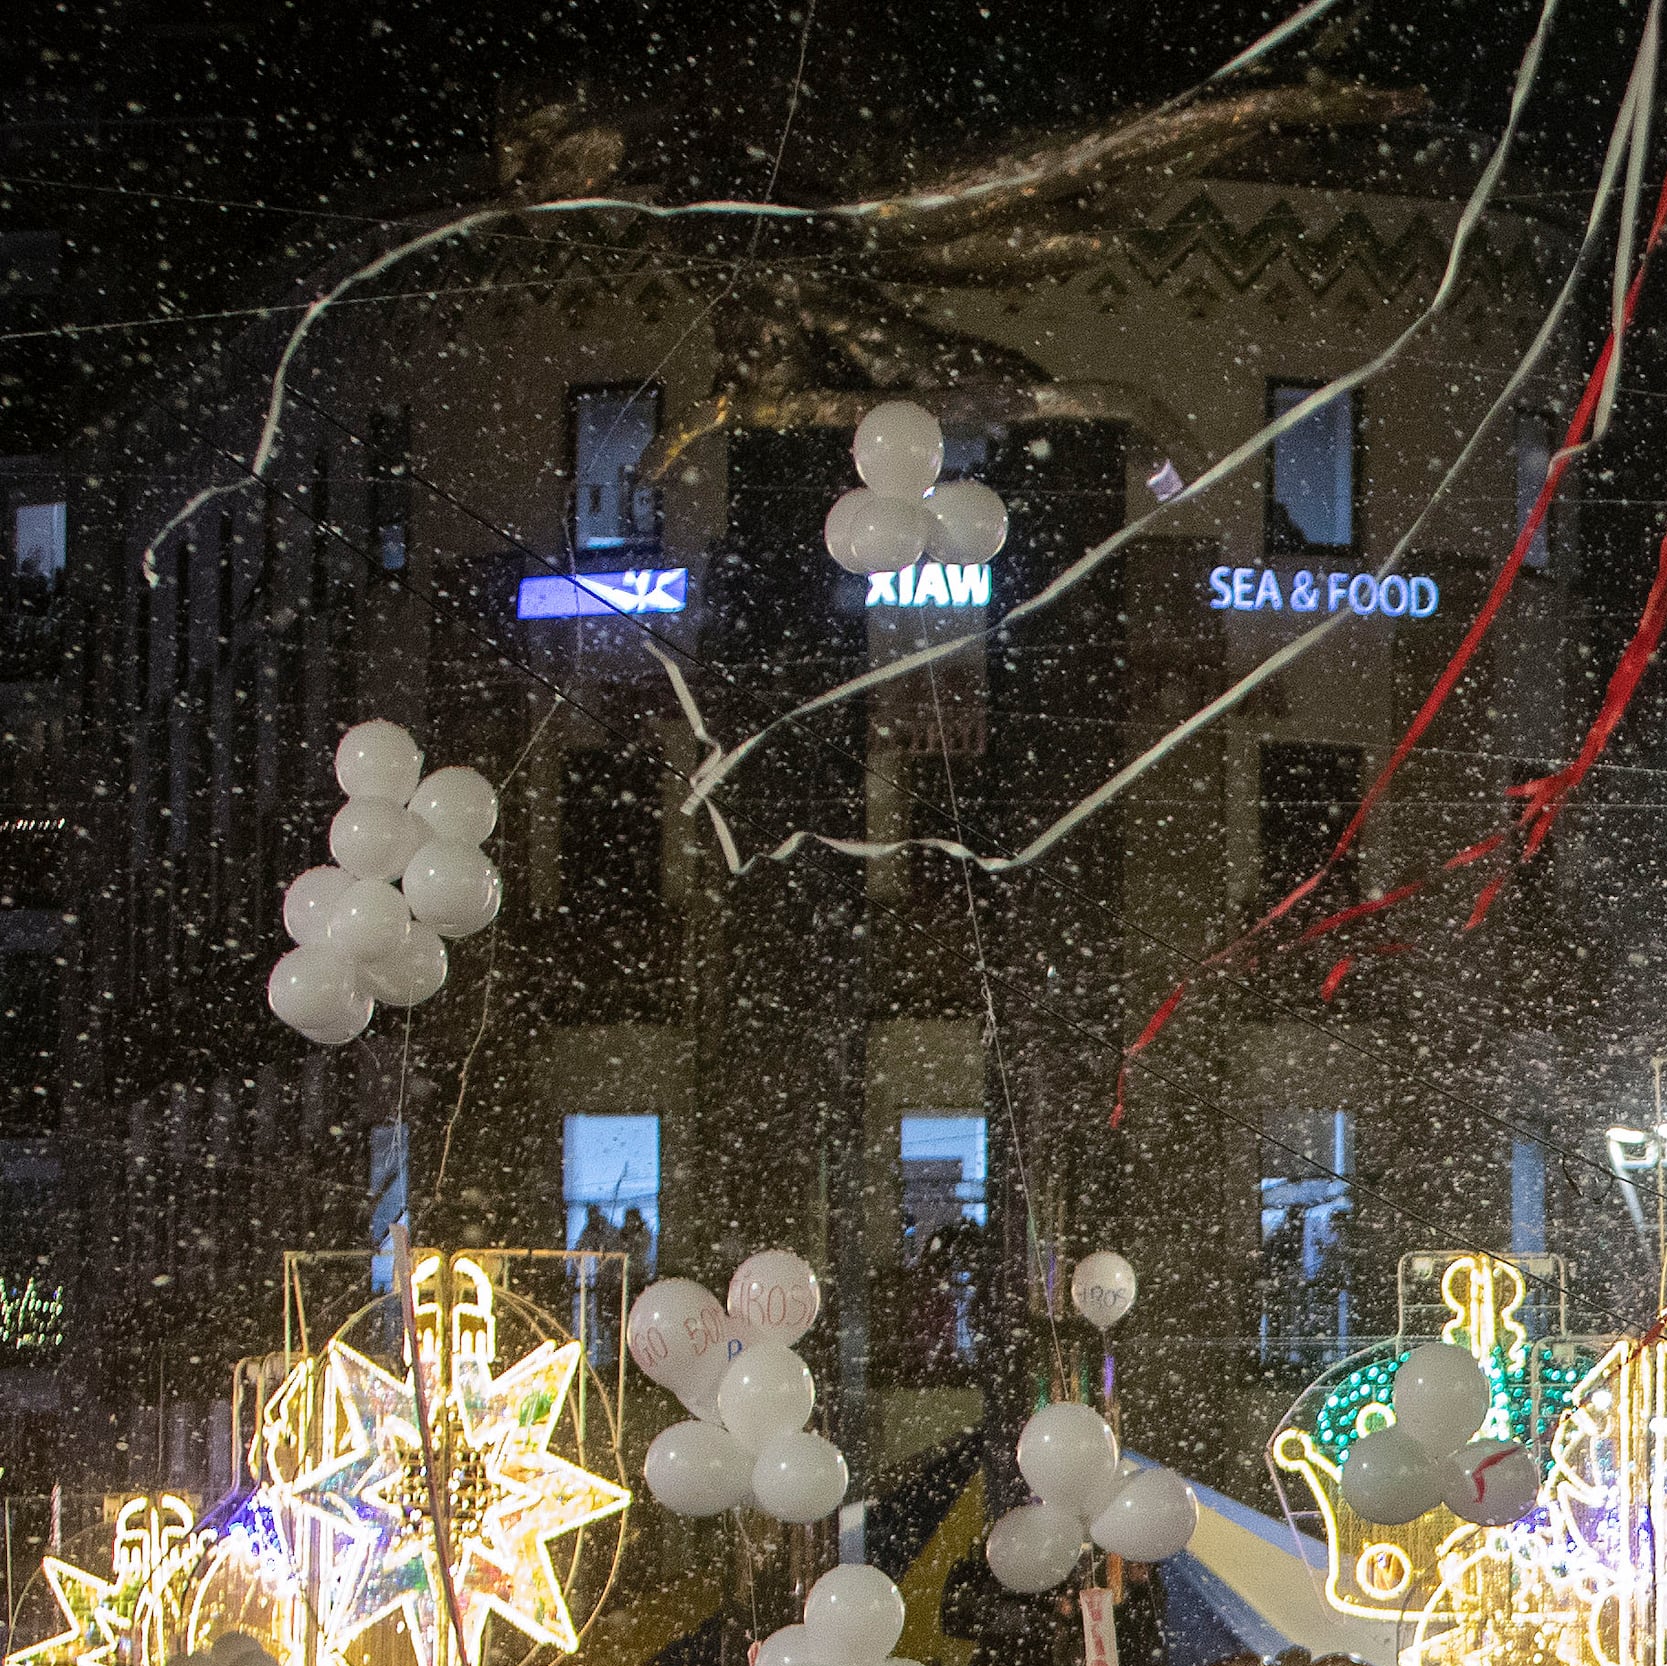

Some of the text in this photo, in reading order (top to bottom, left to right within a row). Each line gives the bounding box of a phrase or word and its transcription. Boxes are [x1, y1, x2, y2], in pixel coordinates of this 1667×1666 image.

[1210, 566, 1439, 618] SEA & FOOD
